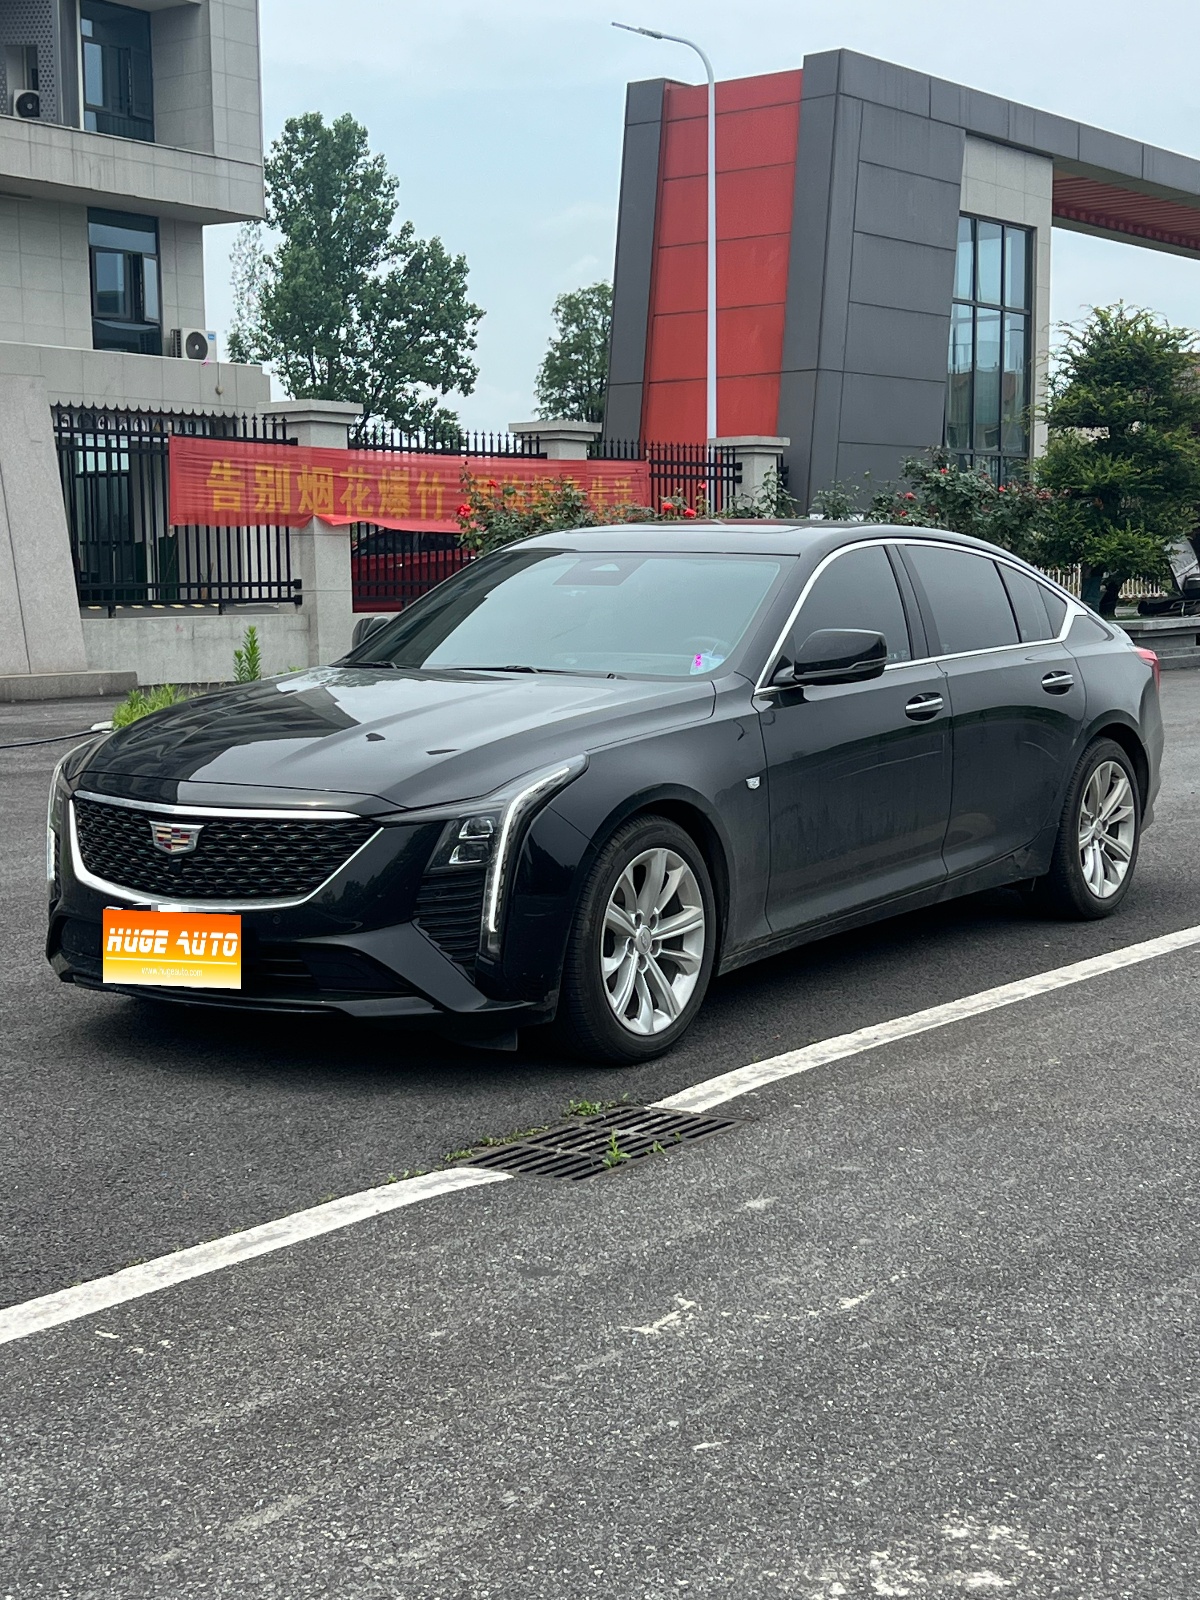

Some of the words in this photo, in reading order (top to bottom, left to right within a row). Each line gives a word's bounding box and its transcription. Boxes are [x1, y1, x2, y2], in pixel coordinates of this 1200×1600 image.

[206, 459, 447, 520] 告别烟花爆竹
